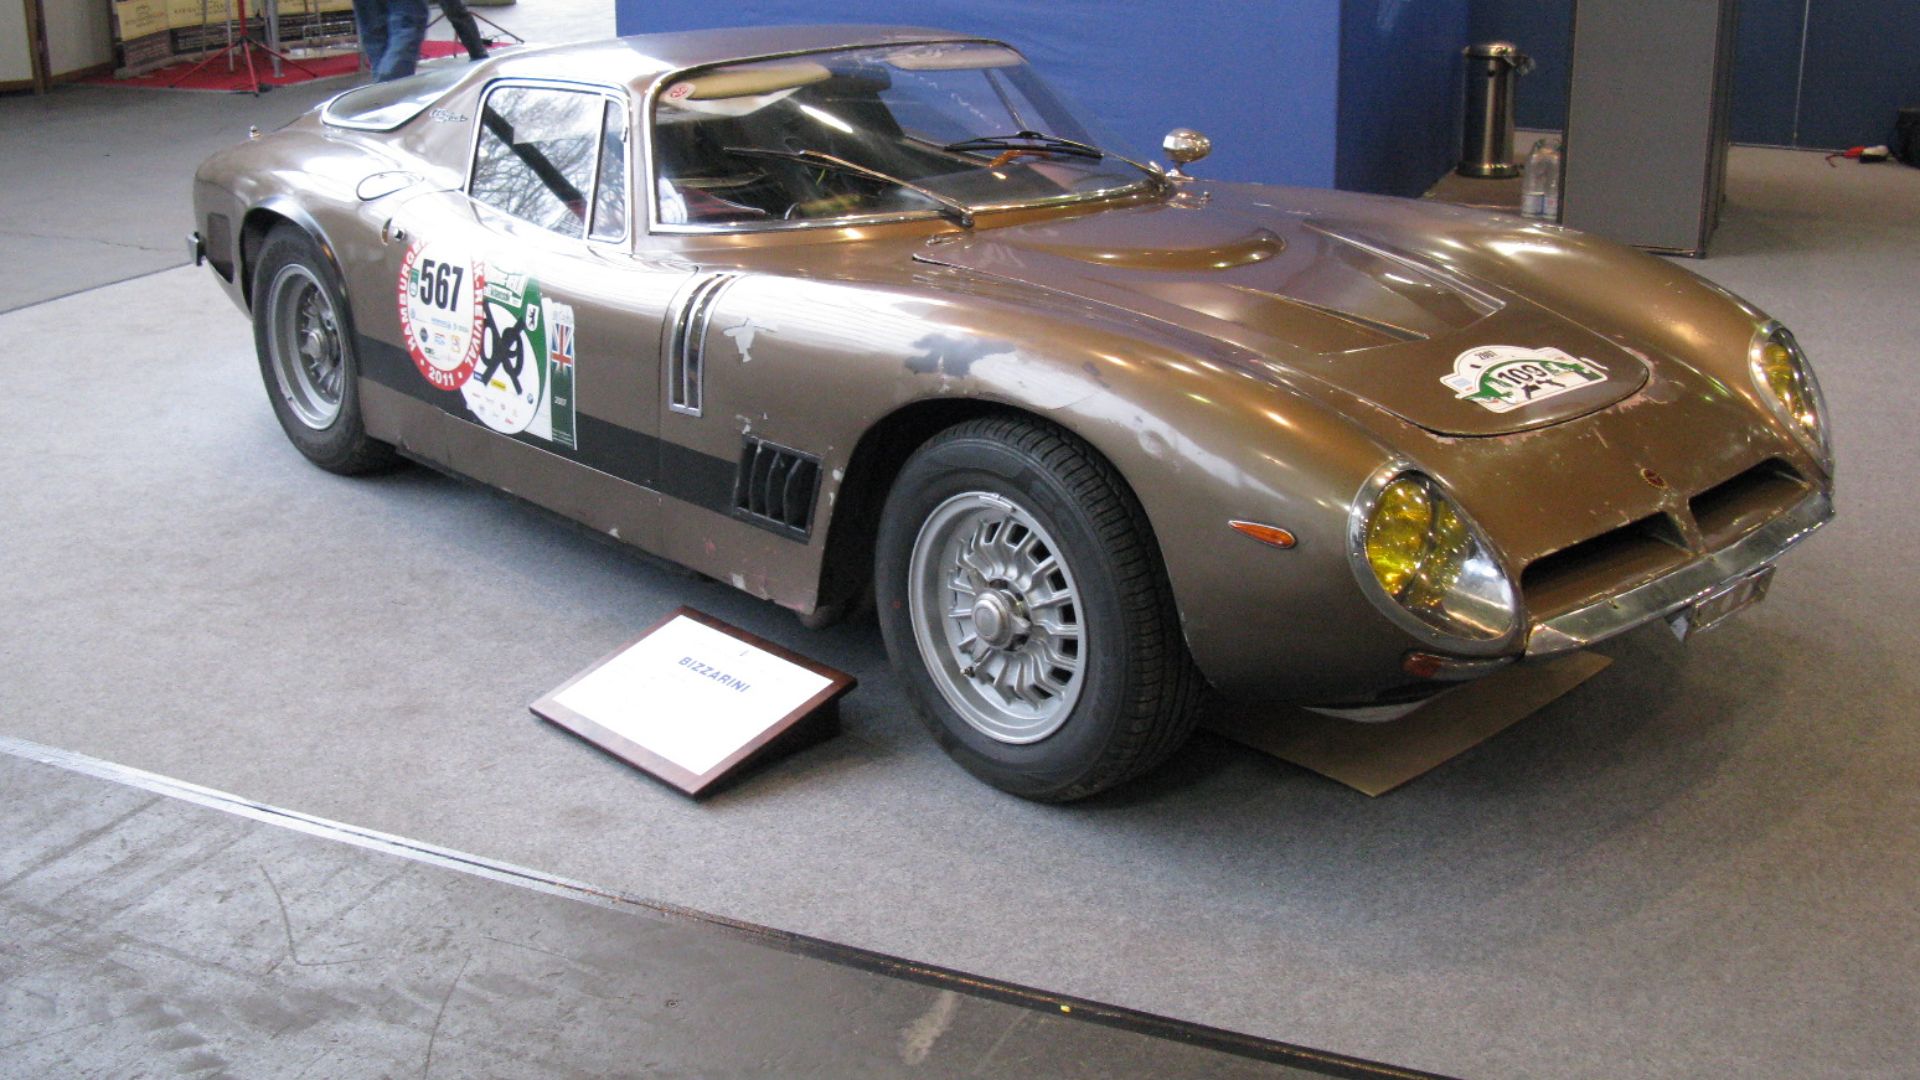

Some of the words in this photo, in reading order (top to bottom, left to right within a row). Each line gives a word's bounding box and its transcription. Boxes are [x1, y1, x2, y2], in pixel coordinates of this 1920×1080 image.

[399, 239, 429, 351] HAMBURGE
[420, 259, 464, 311] 567
[428, 366, 455, 387] 2011
[1498, 364, 1548, 385] 109
[678, 656, 751, 693] BIZZARINI
